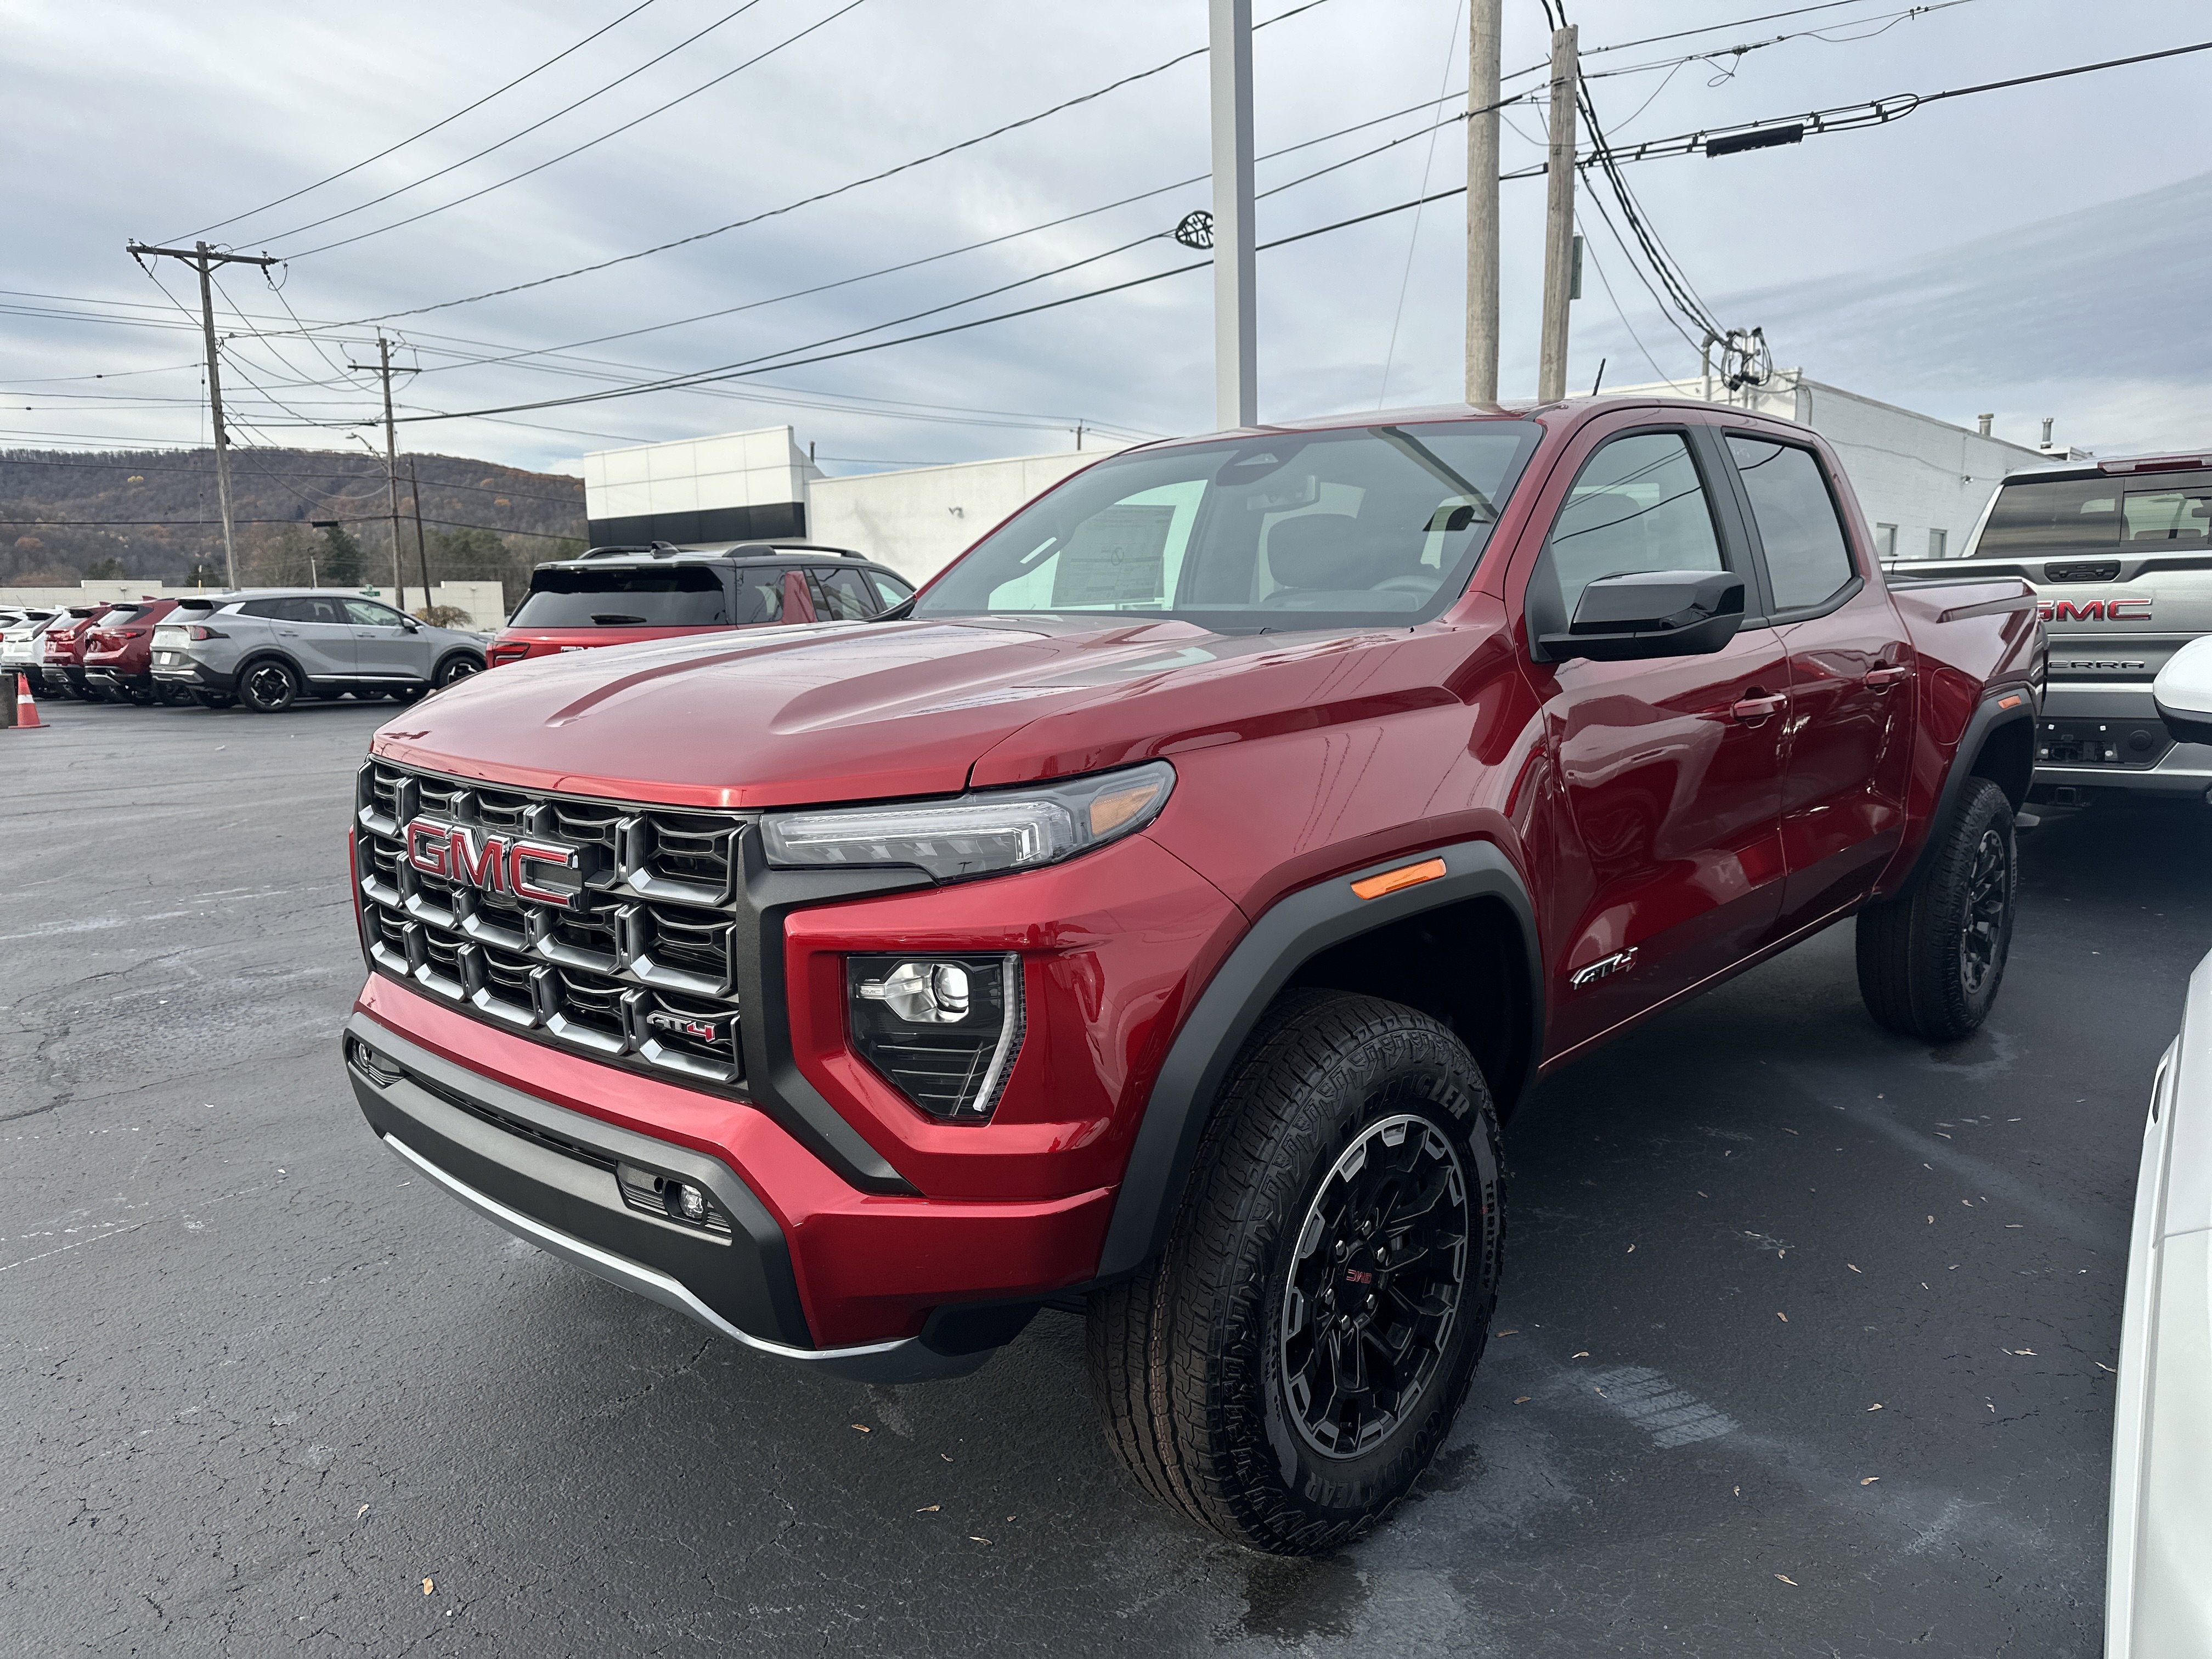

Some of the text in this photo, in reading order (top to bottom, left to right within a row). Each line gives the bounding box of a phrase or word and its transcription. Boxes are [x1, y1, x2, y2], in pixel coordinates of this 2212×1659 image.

[407, 815, 579, 912] GMC
[646, 1011, 715, 1042] AT4
[1346, 1268, 1372, 1284] GMC
